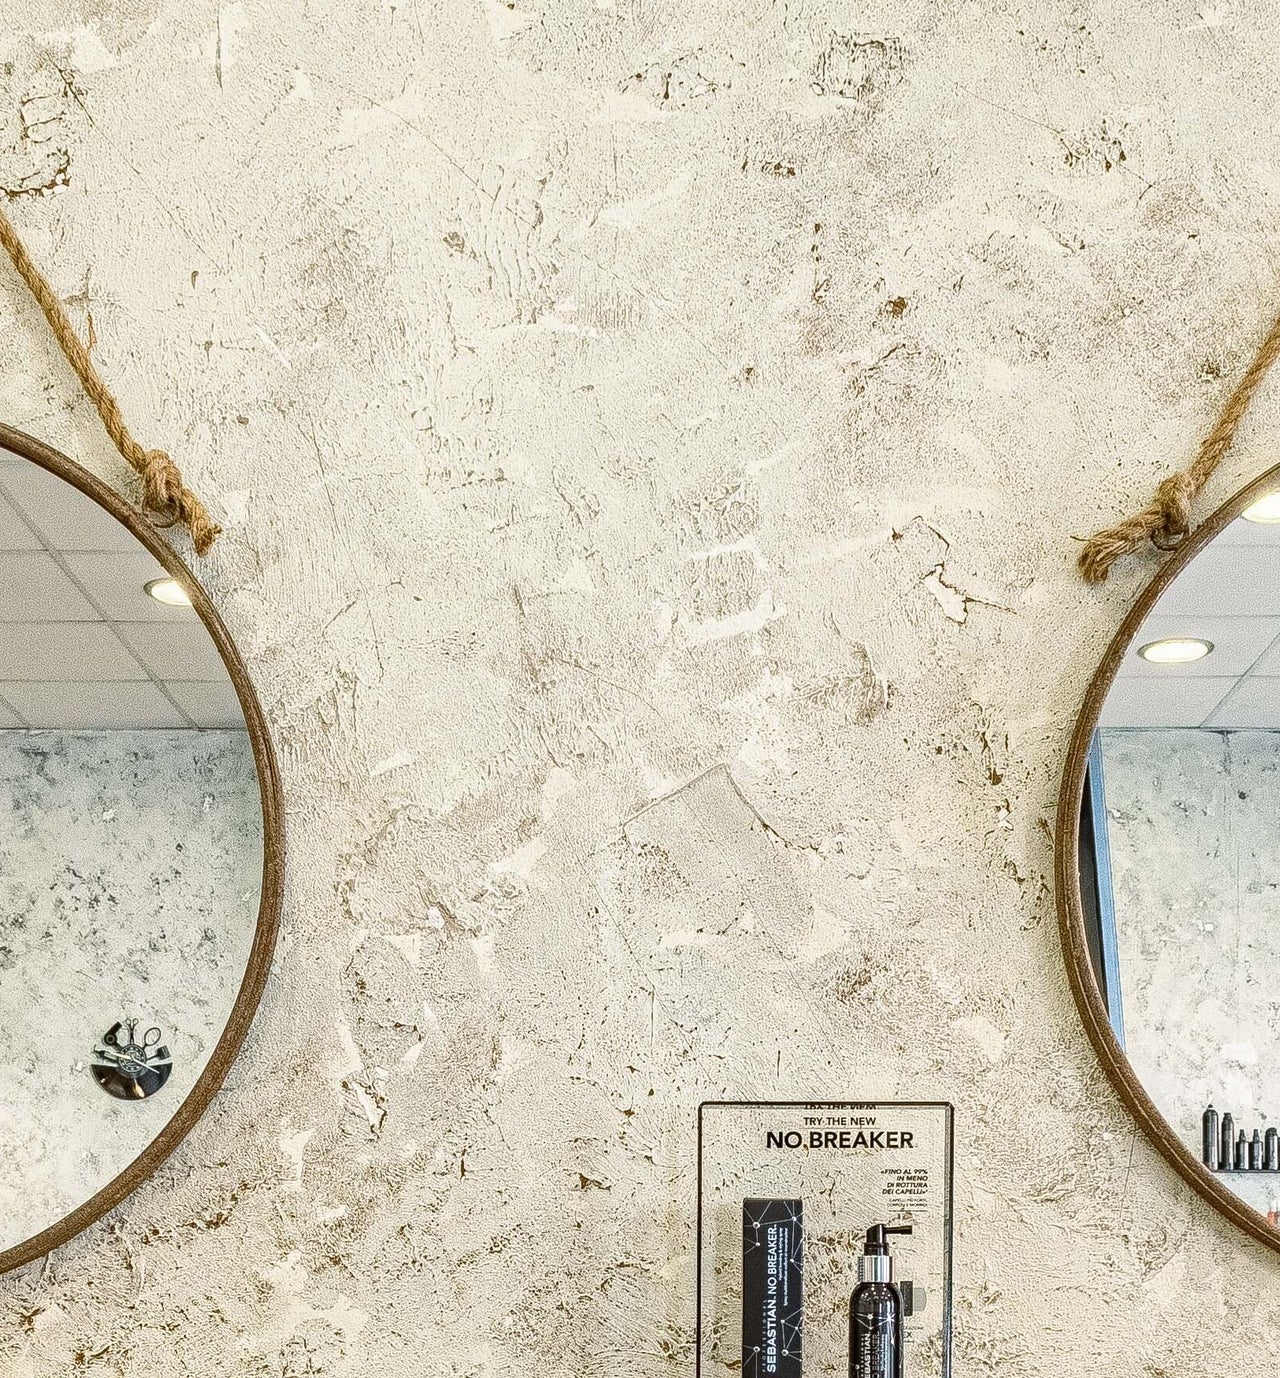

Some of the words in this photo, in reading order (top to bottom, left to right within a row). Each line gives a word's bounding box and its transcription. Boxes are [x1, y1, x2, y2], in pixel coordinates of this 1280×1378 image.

[803, 1117, 823, 1126] TRY
[826, 1117, 847, 1126] THE
[850, 1117, 877, 1126] NEW
